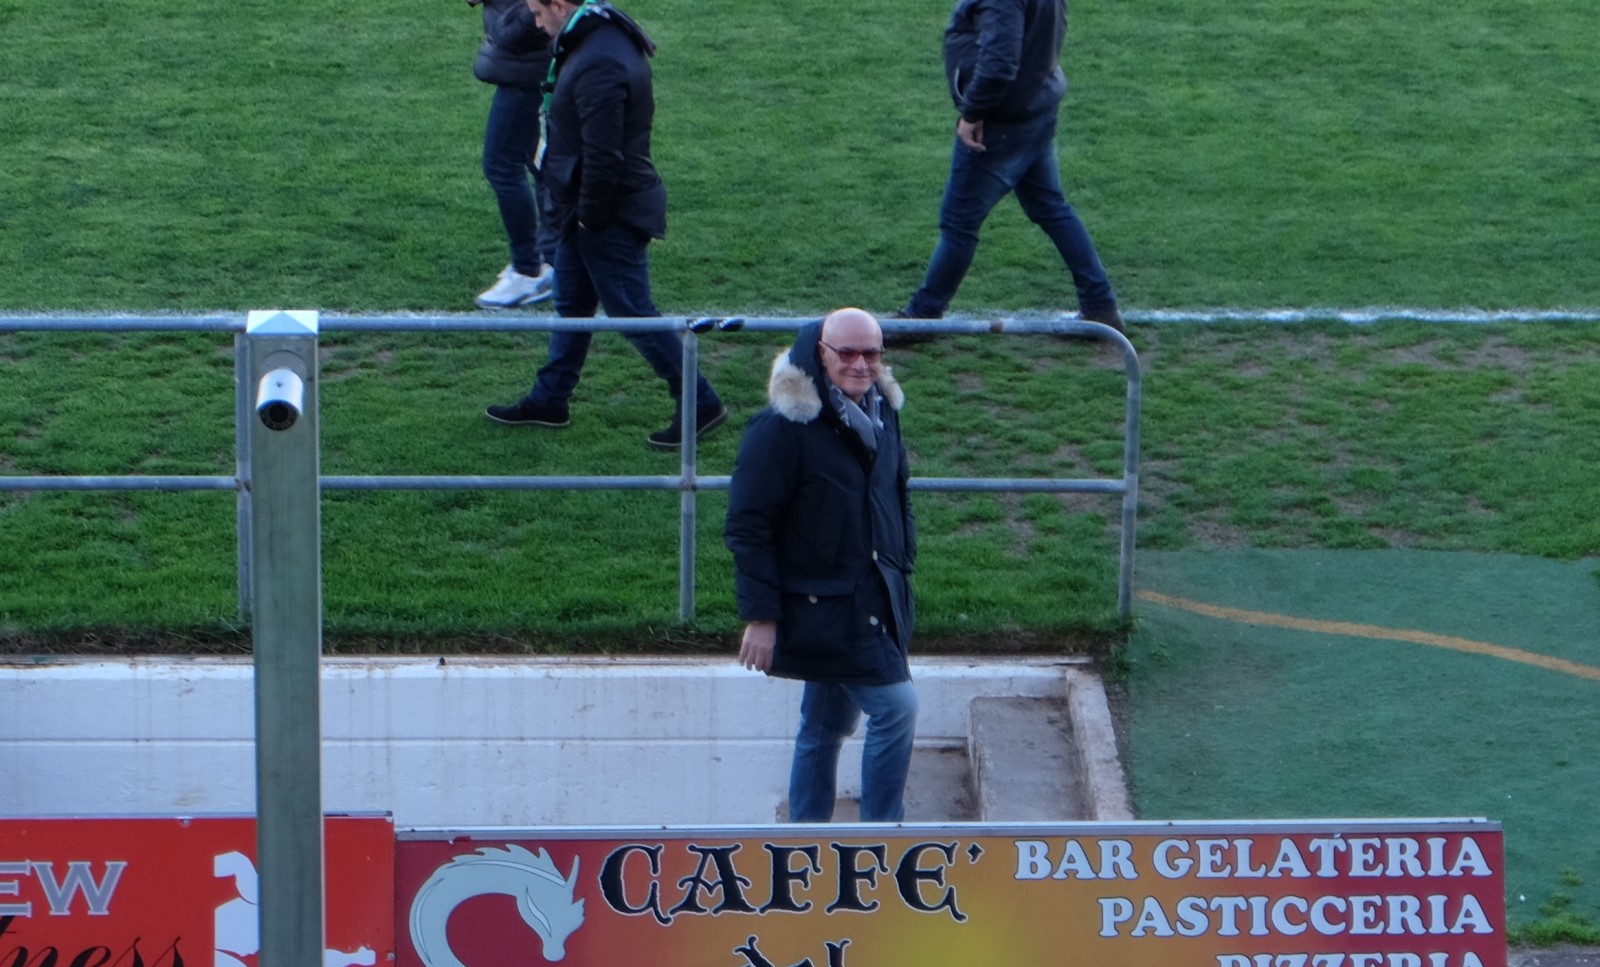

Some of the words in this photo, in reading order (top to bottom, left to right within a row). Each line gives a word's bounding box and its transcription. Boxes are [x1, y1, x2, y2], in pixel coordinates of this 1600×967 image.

[1014, 838, 1140, 880] BAR
[1152, 836, 1494, 879] GELATERIA
[1098, 894, 1495, 937] PASTICCERIA
